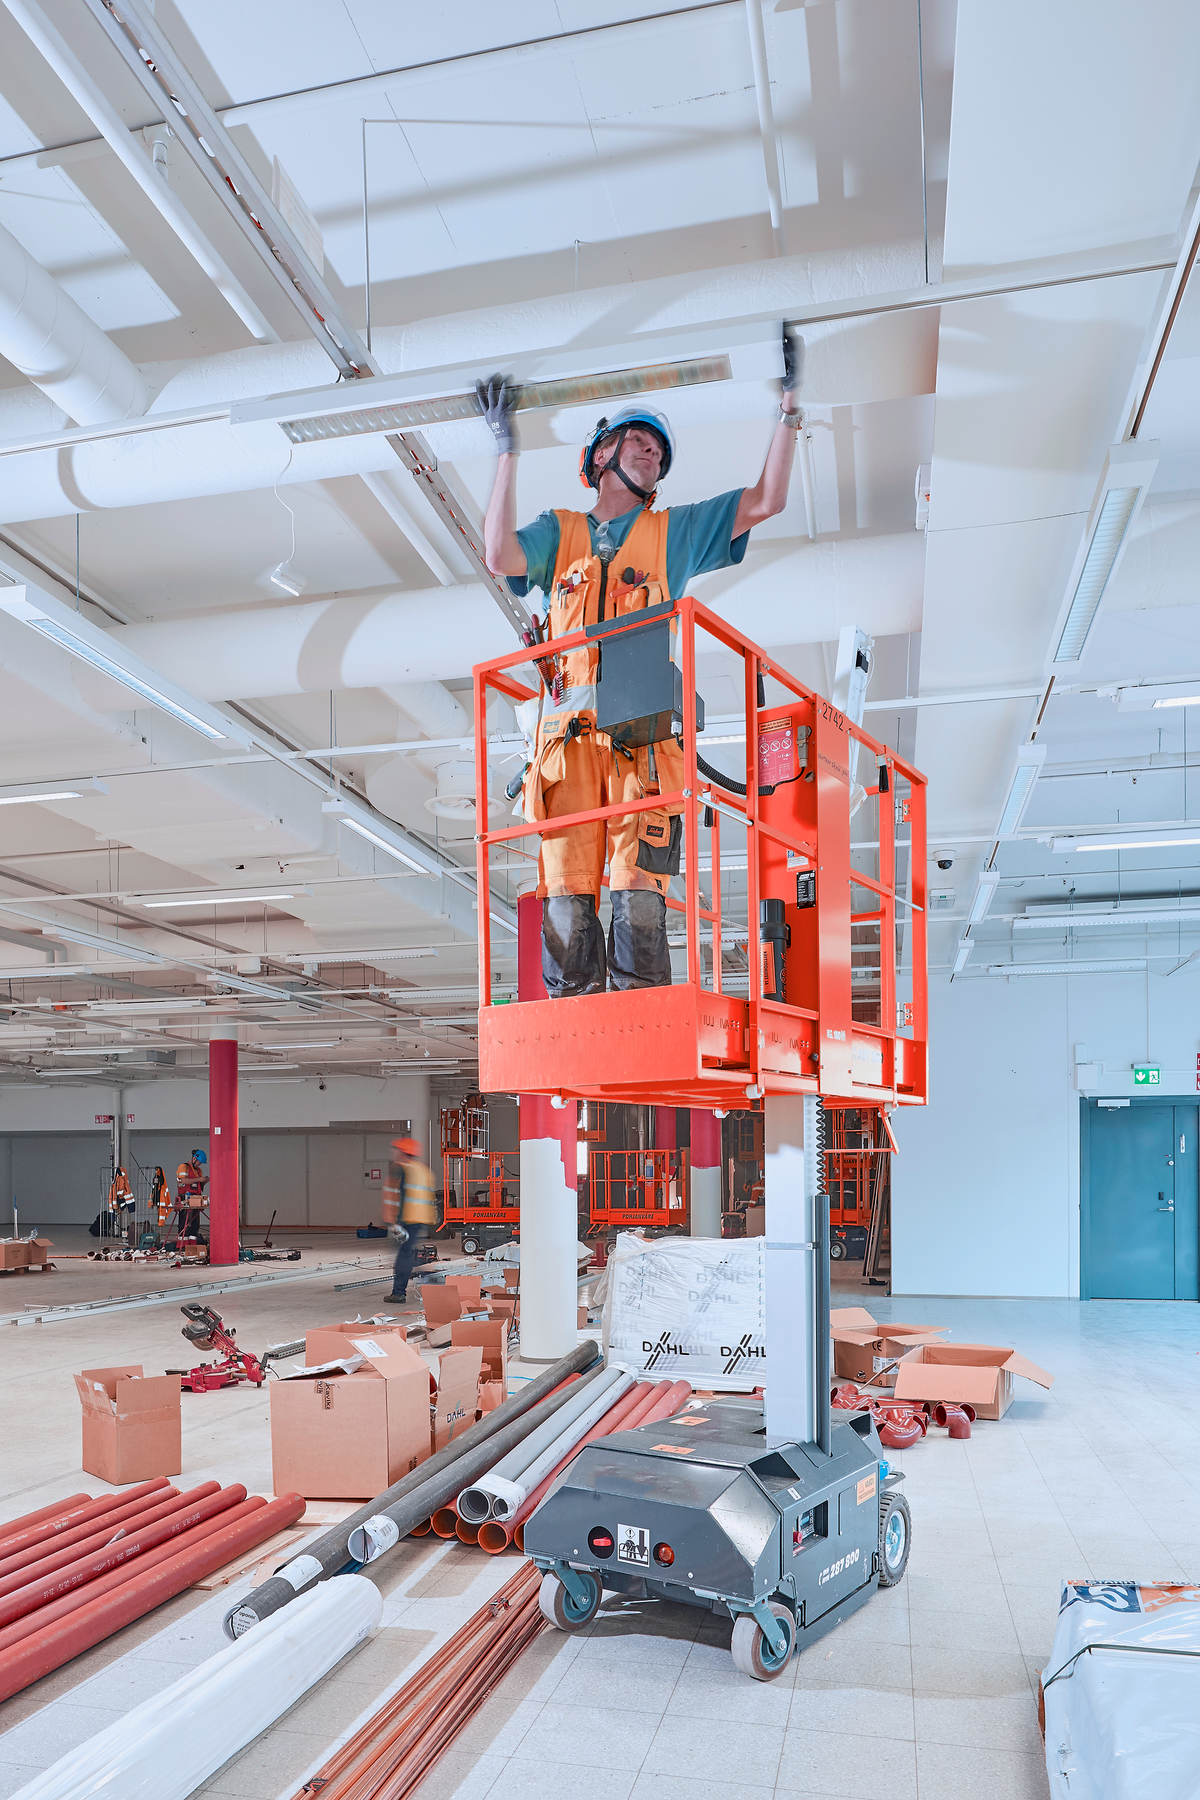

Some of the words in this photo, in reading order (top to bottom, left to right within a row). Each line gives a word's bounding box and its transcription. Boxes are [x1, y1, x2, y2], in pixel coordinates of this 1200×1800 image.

[822, 702, 844, 732] 2742
[642, 1341, 690, 1356] DAHL
[720, 1346, 767, 1358] DAHL
[446, 1408, 466, 1424] DAHL
[830, 1557, 844, 1579] 287
[845, 1548, 860, 1569] 800
